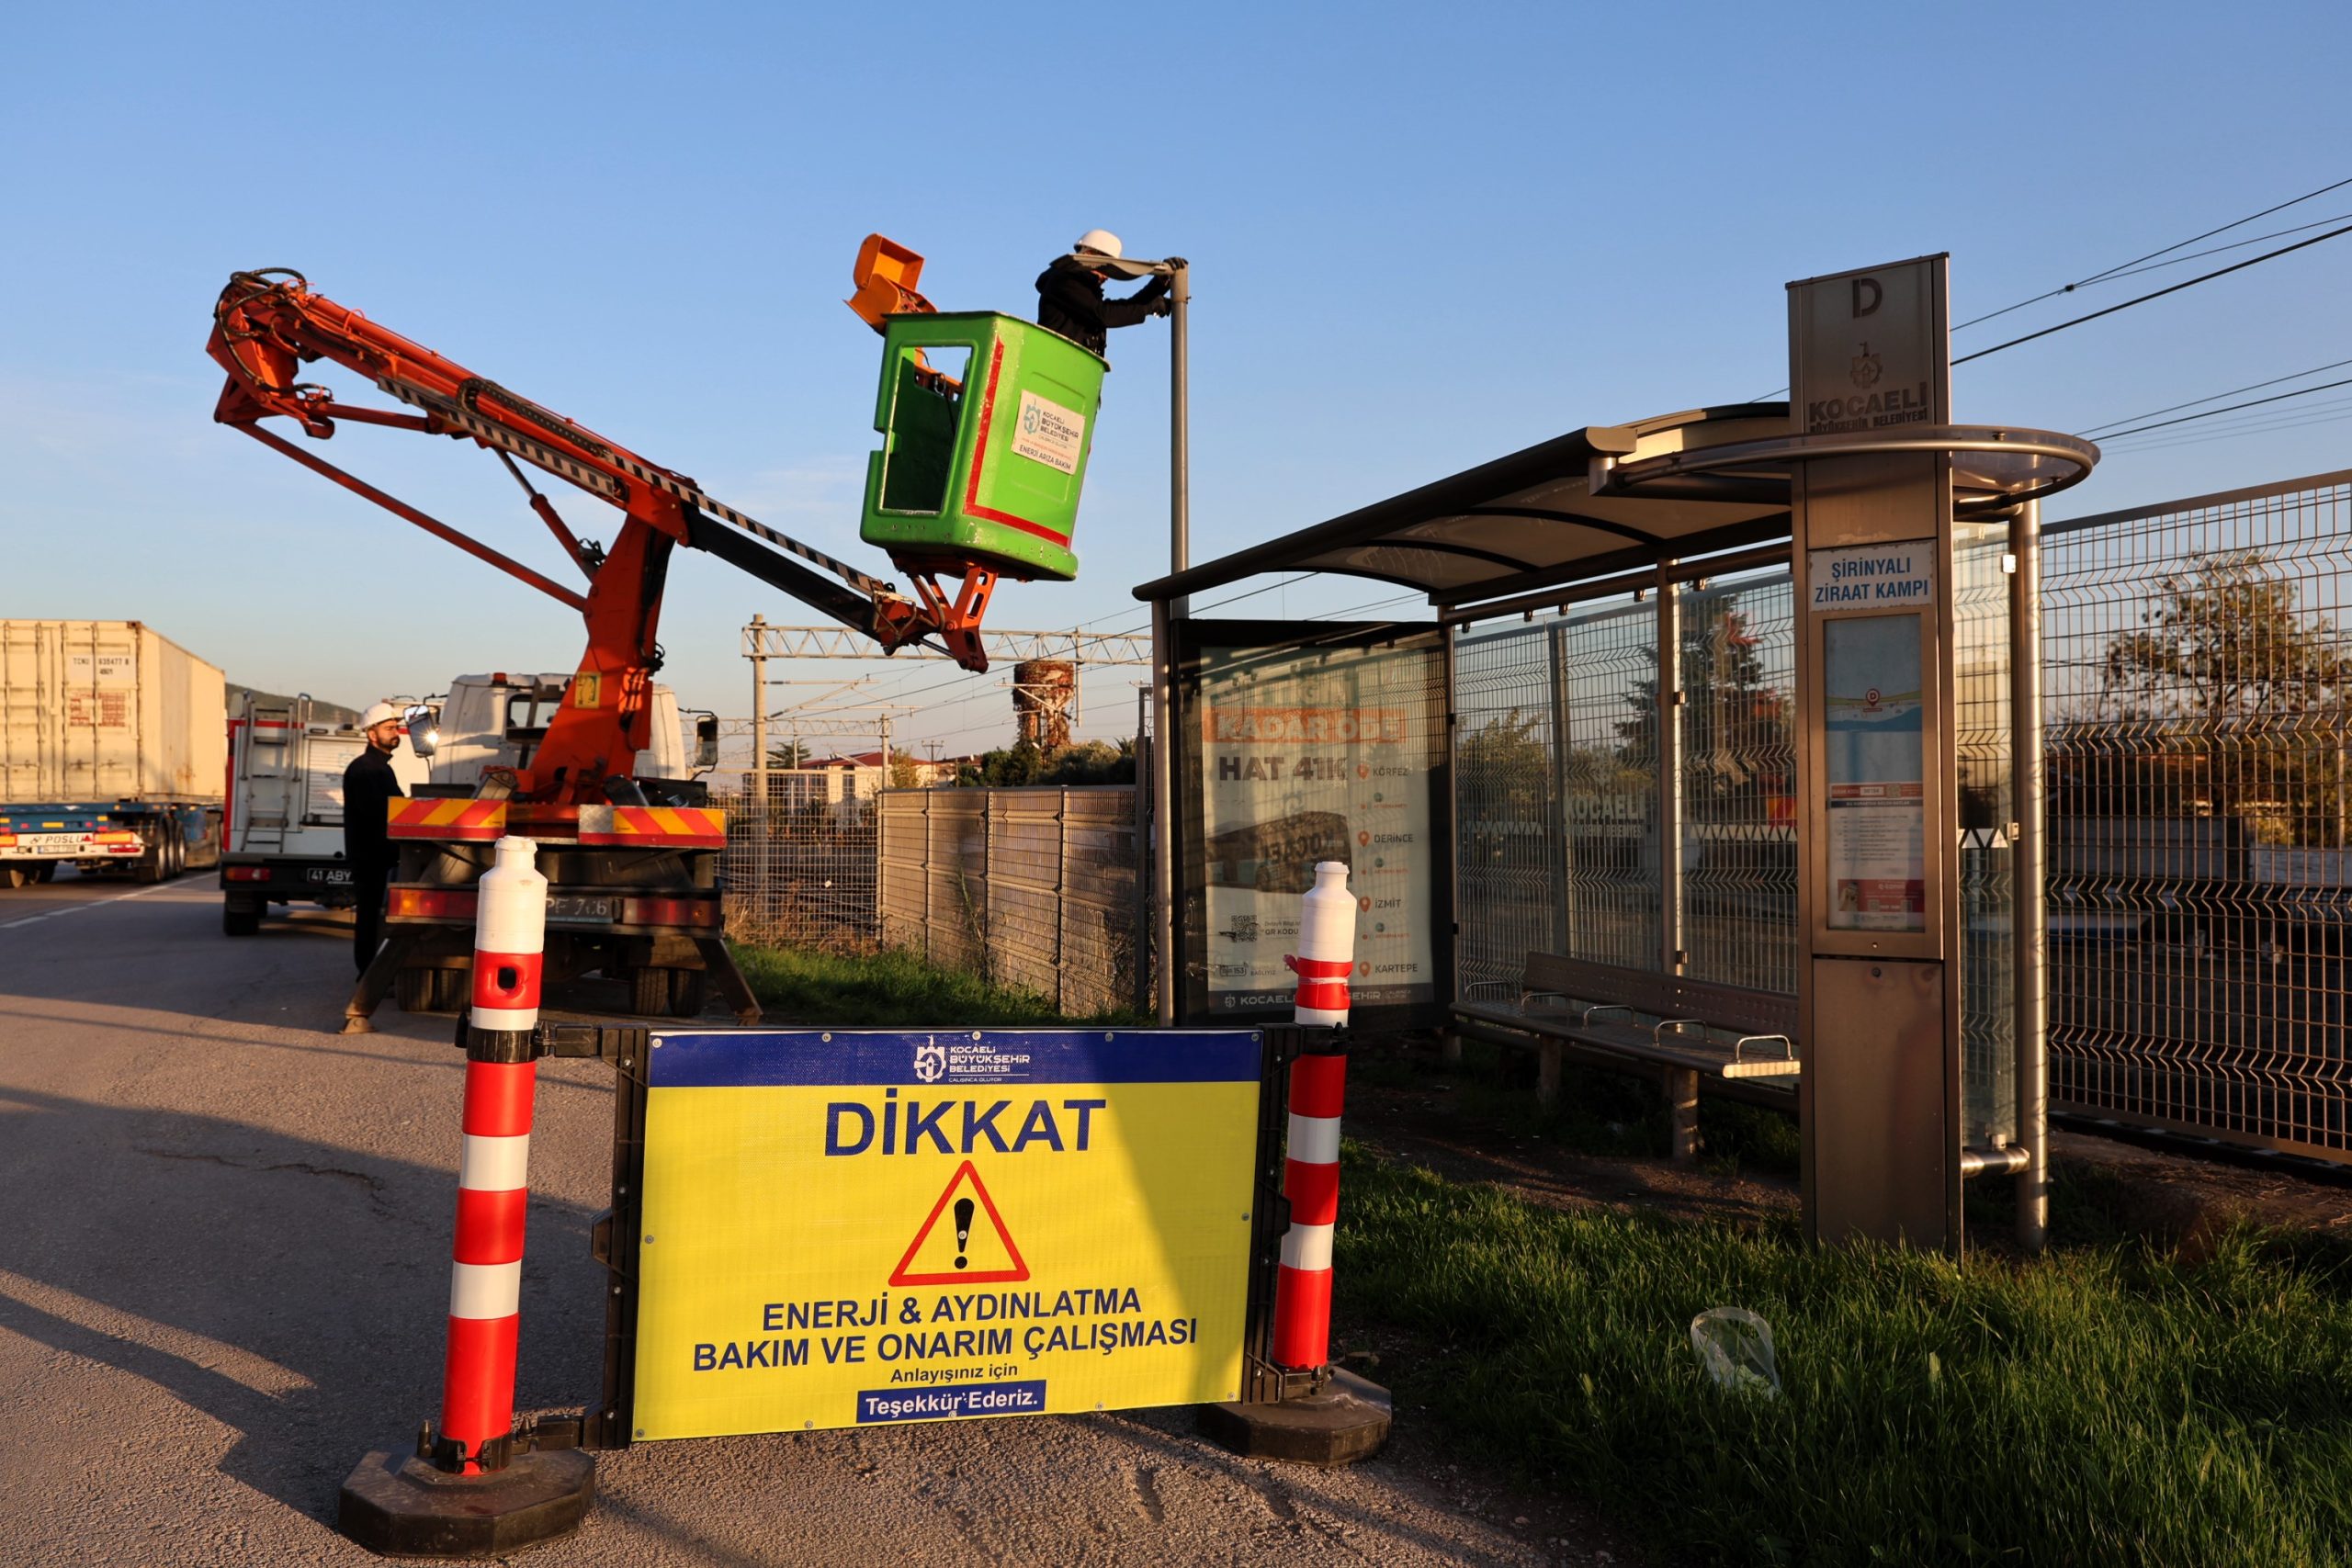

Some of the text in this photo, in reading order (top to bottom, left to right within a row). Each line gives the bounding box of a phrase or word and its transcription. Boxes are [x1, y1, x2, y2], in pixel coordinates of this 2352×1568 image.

[1851, 277, 1883, 319] D
[1054, 458, 1071, 470] BAKIM
[1831, 557, 1911, 582] ŞİRİNYALI
[1815, 580, 1928, 603] ZİRAAT KAMPI
[1217, 714, 1329, 740] KADAR
[1218, 756, 1284, 782] HAT
[1373, 766, 1408, 776] KÖRFEZ
[1374, 833, 1414, 843] DERİNCE
[325, 870, 352, 882] ABY
[1374, 897, 1402, 908] İZMİT
[1264, 928, 1276, 936] QR
[1374, 964, 1419, 974] KARTEPE
[950, 1045, 996, 1054] KOCAELİ
[949, 1055, 1031, 1065] BÜYÜKŞEHİR
[949, 1065, 1011, 1073] BELEDİYESİ
[824, 1088, 1107, 1156] DİKKAT
[763, 1287, 1142, 1331] ENERJİ & AYDINLATMA
[693, 1318, 1197, 1371] BAKIM VE ONARIM ÇALIŞMASI
[889, 1363, 1018, 1384] Anlayışınız için
[865, 1388, 1038, 1418] Teşekkür Ederiz.
